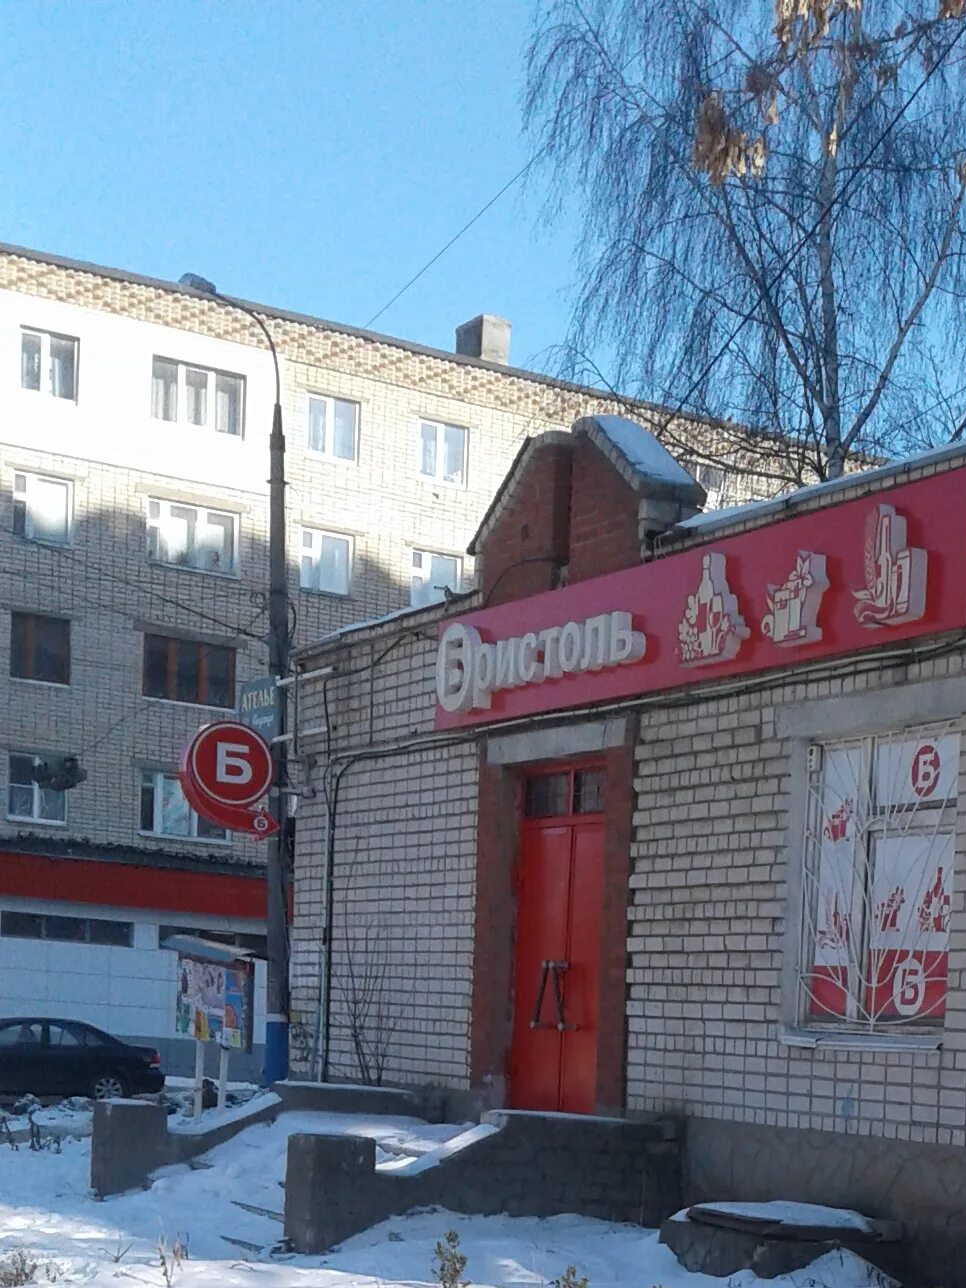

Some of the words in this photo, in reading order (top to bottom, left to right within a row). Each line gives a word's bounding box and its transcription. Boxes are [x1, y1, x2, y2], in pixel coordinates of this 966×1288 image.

[435, 610, 647, 712] Бристоль
[241, 686, 275, 712] АТЕЛЬЕ
[216, 741, 253, 784] Б
